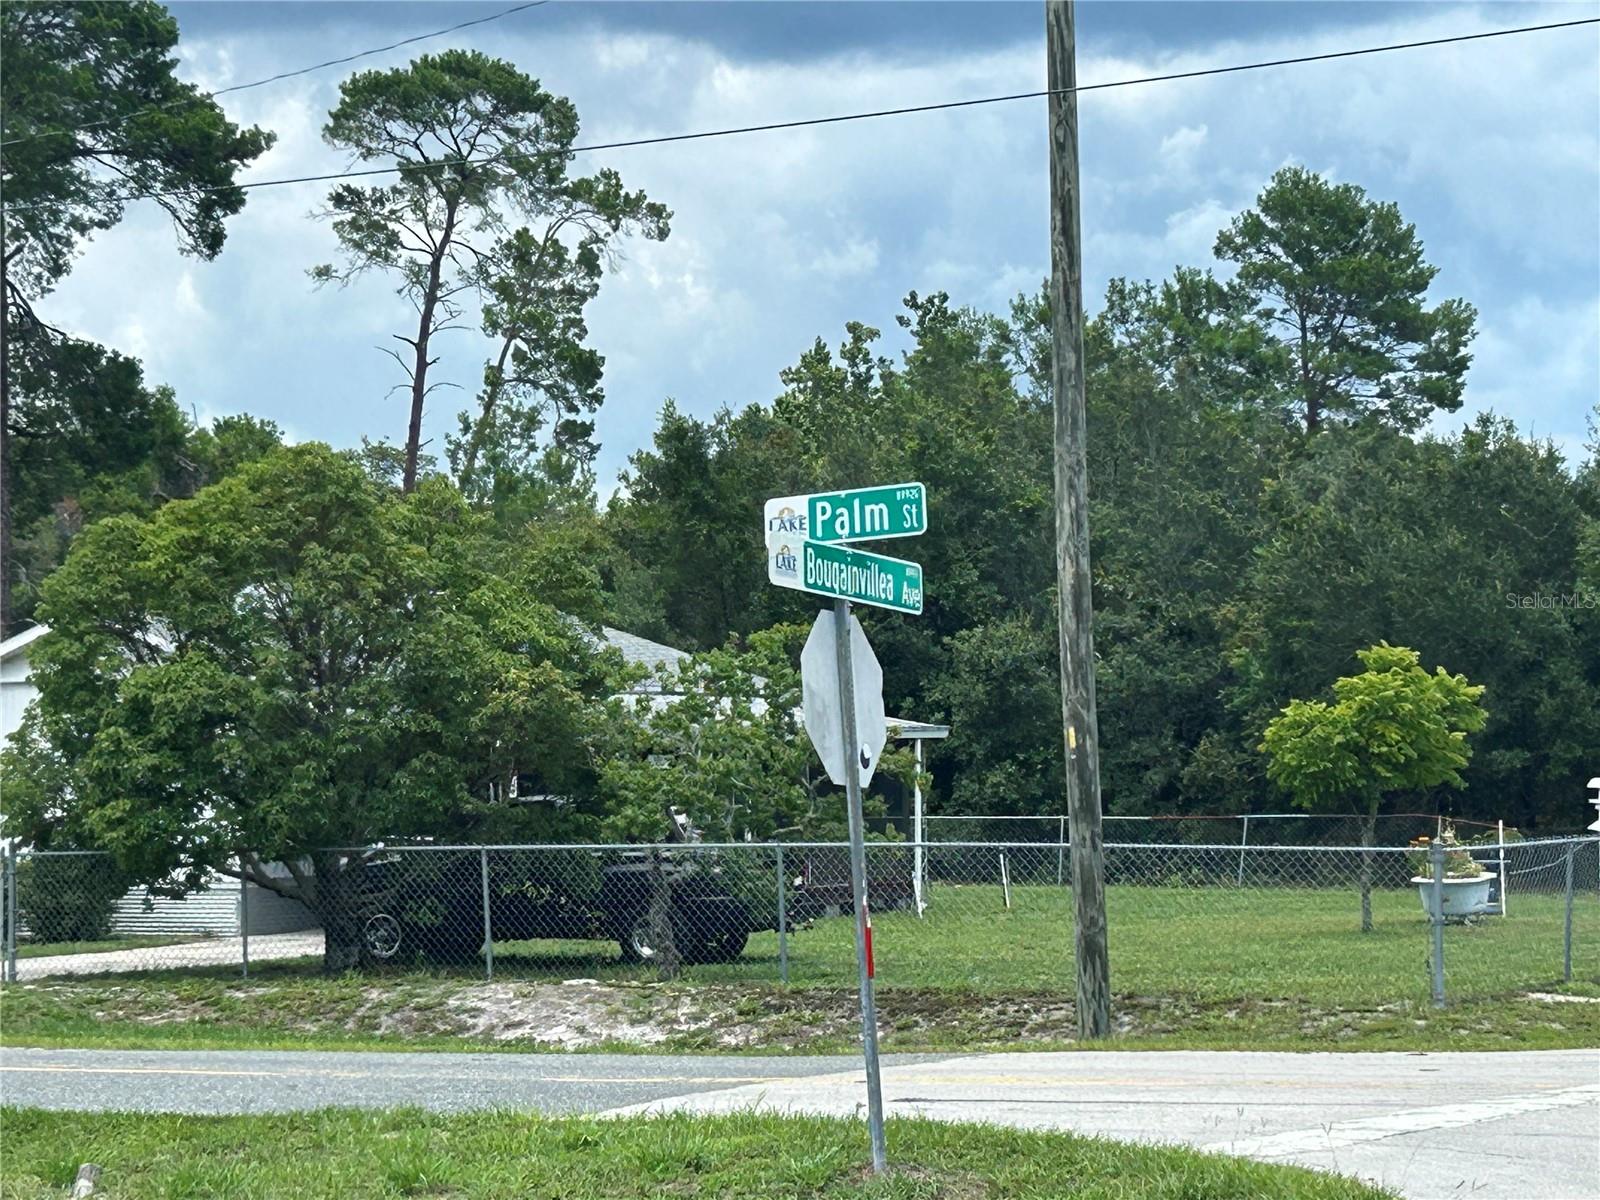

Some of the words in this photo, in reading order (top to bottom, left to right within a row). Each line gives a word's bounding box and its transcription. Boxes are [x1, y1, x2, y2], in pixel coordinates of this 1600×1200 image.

[815, 498, 890, 538] Palm
[902, 504, 919, 528] St
[806, 548, 894, 601] Bougainvillea
[902, 581, 920, 607] Ave
